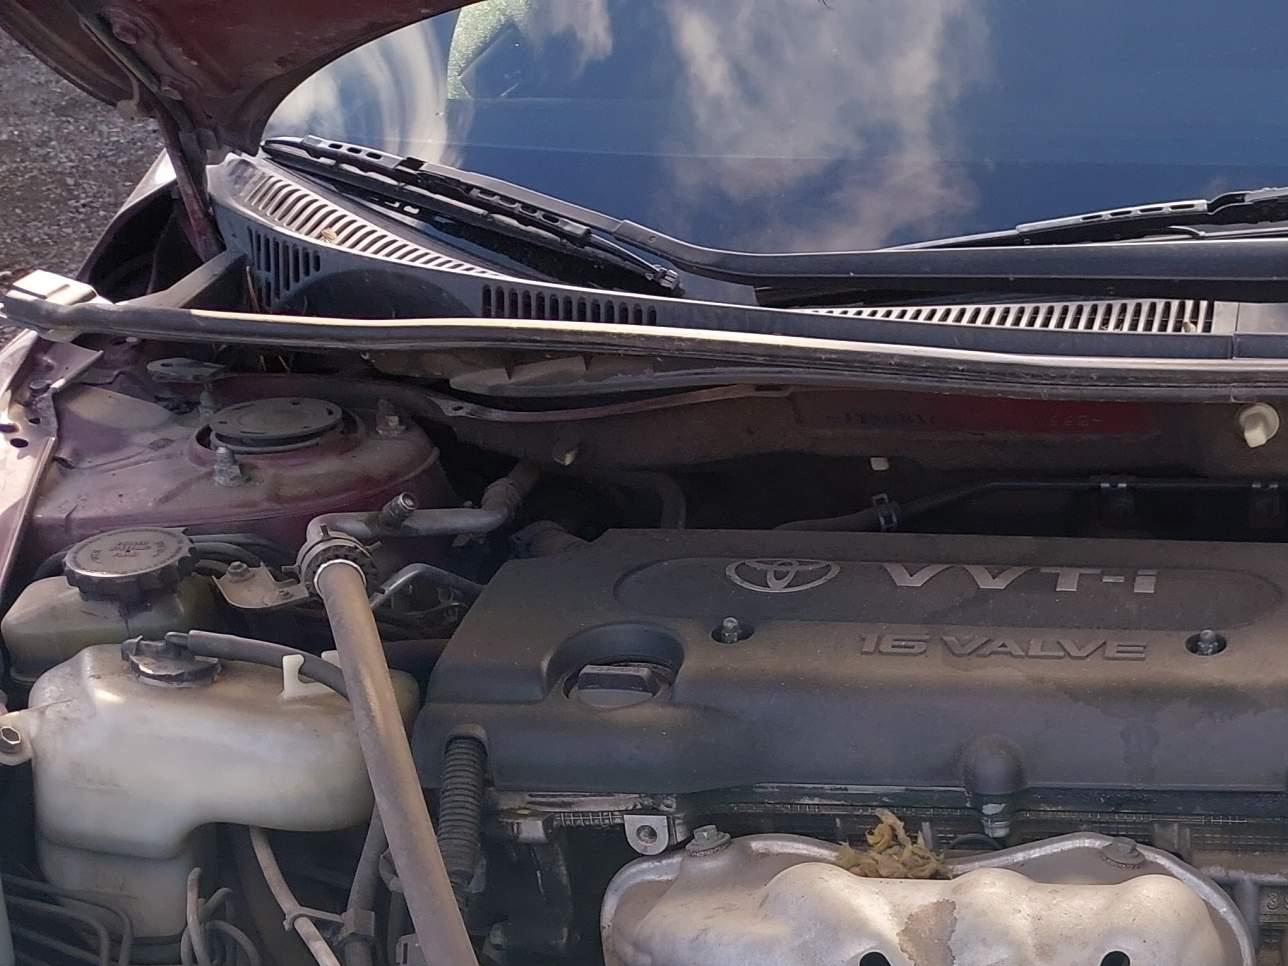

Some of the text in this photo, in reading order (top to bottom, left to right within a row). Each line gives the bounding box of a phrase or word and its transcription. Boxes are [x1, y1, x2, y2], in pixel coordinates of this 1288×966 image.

[881, 563, 1158, 593] VVT-i
[860, 633, 1147, 661] 16 VALVE
